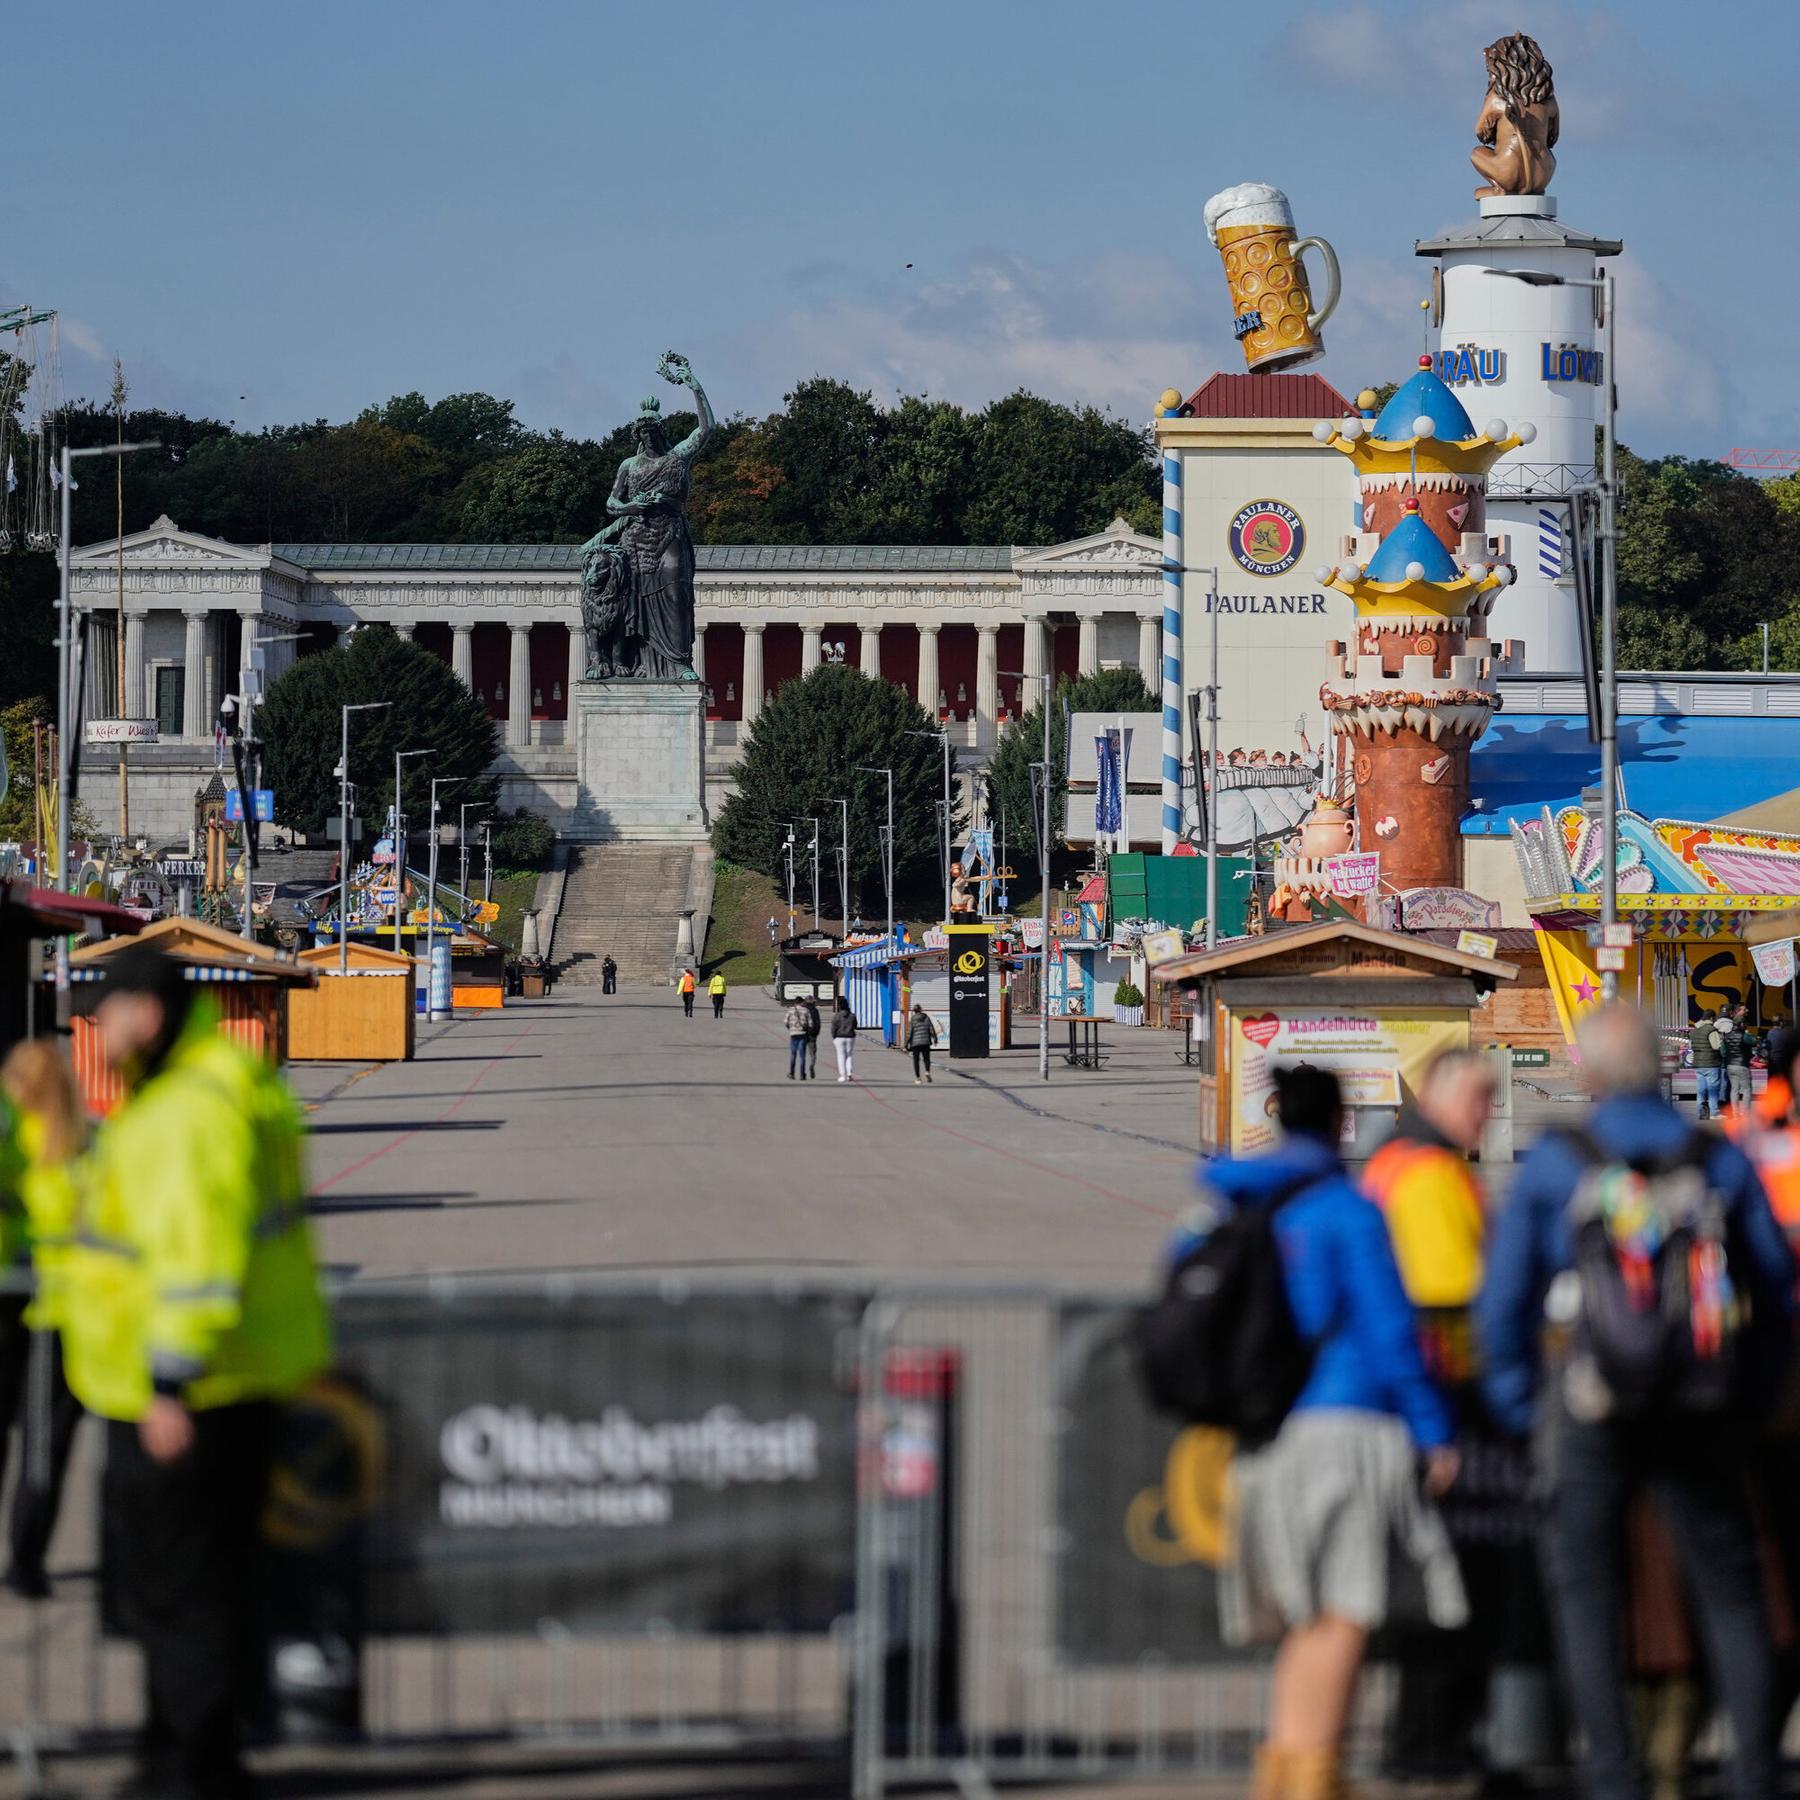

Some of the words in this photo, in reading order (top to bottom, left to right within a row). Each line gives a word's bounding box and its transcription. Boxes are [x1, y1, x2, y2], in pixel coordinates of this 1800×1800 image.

[1234, 311, 1261, 335] ER
[1233, 502, 1300, 530] PAULANER
[1239, 554, 1295, 574] MÜNCHEN
[1351, 952, 1406, 968] Mandeln
[1288, 1016, 1377, 1034] Mandelhütte
